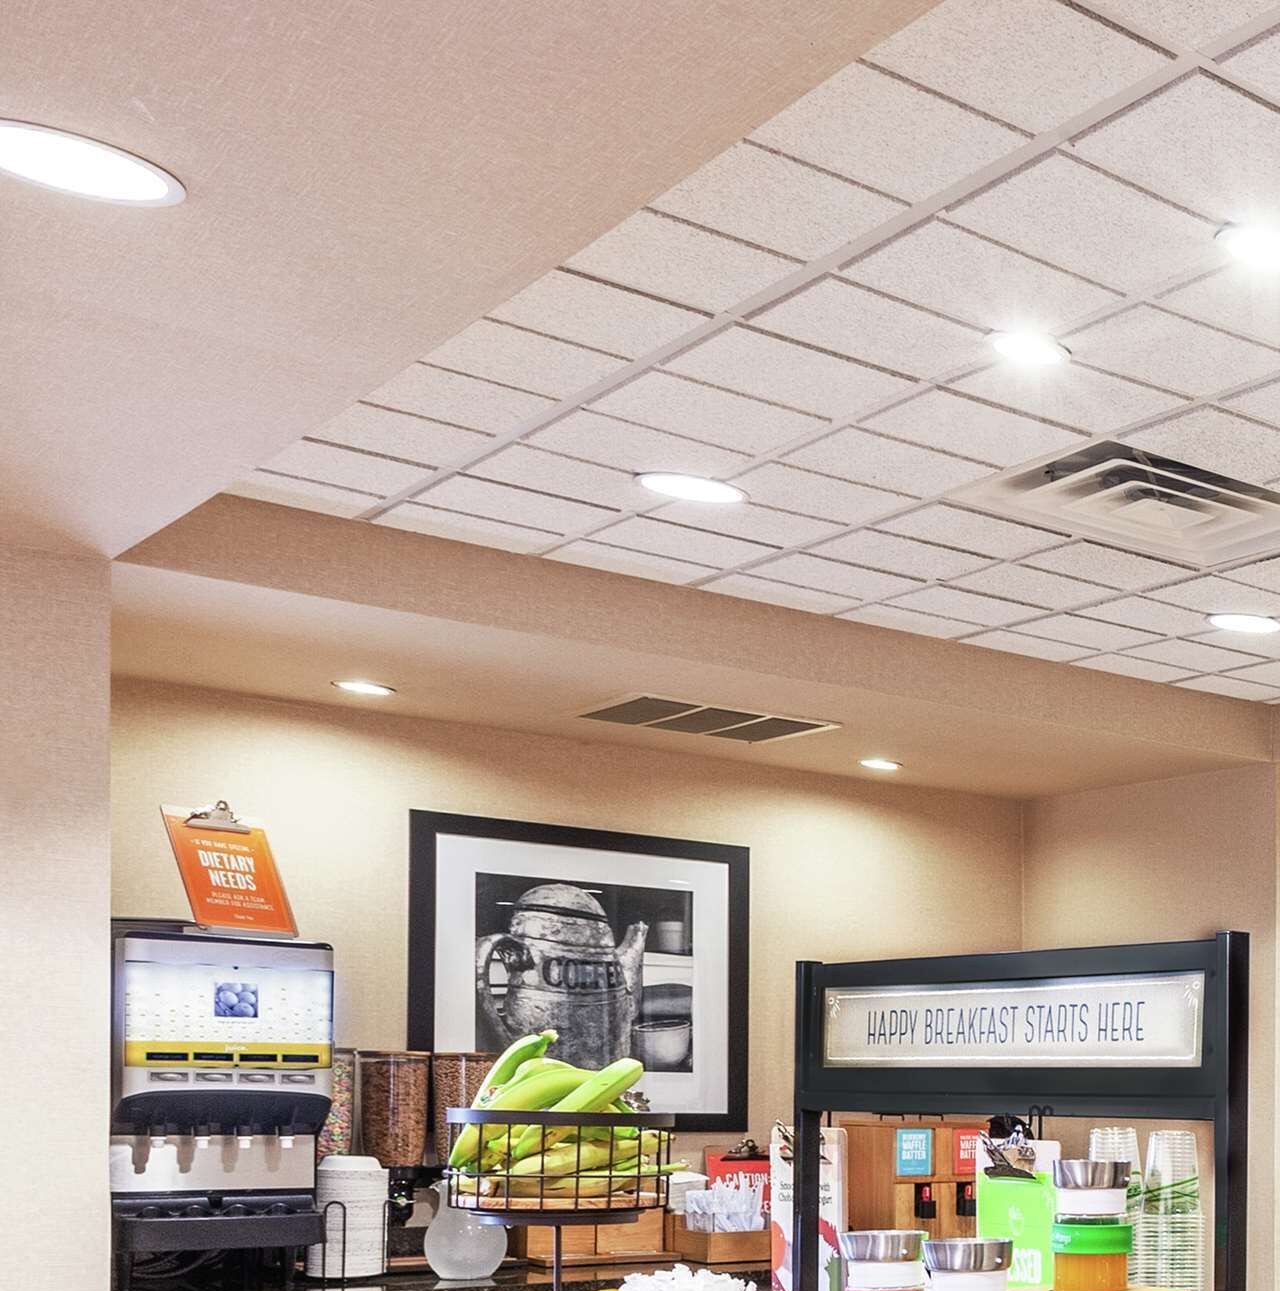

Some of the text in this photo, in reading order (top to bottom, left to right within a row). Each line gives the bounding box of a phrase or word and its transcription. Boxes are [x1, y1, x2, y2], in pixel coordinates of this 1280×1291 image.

[197, 849, 256, 873] DIETARY
[207, 868, 257, 891] NEEDS
[867, 1001, 1146, 1045] HAPPY BREAKFAST STARTS HERE
[960, 1150, 977, 1160] BATT
